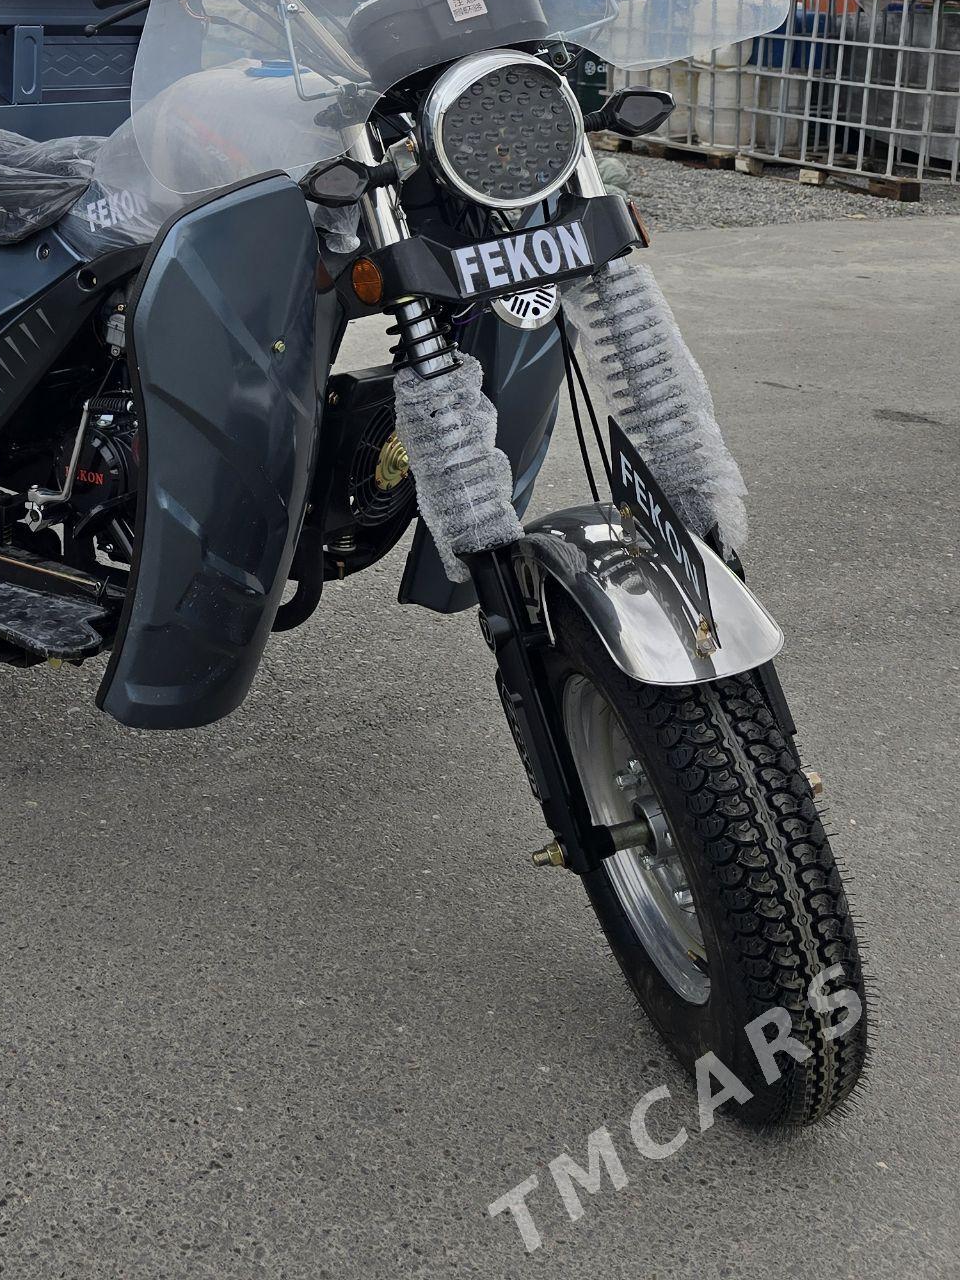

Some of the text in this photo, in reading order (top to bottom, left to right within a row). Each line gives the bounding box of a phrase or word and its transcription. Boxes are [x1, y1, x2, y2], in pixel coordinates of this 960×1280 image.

[86, 190, 149, 232] FEKON
[456, 222, 591, 294] FEKON
[619, 451, 702, 600] FEKON
